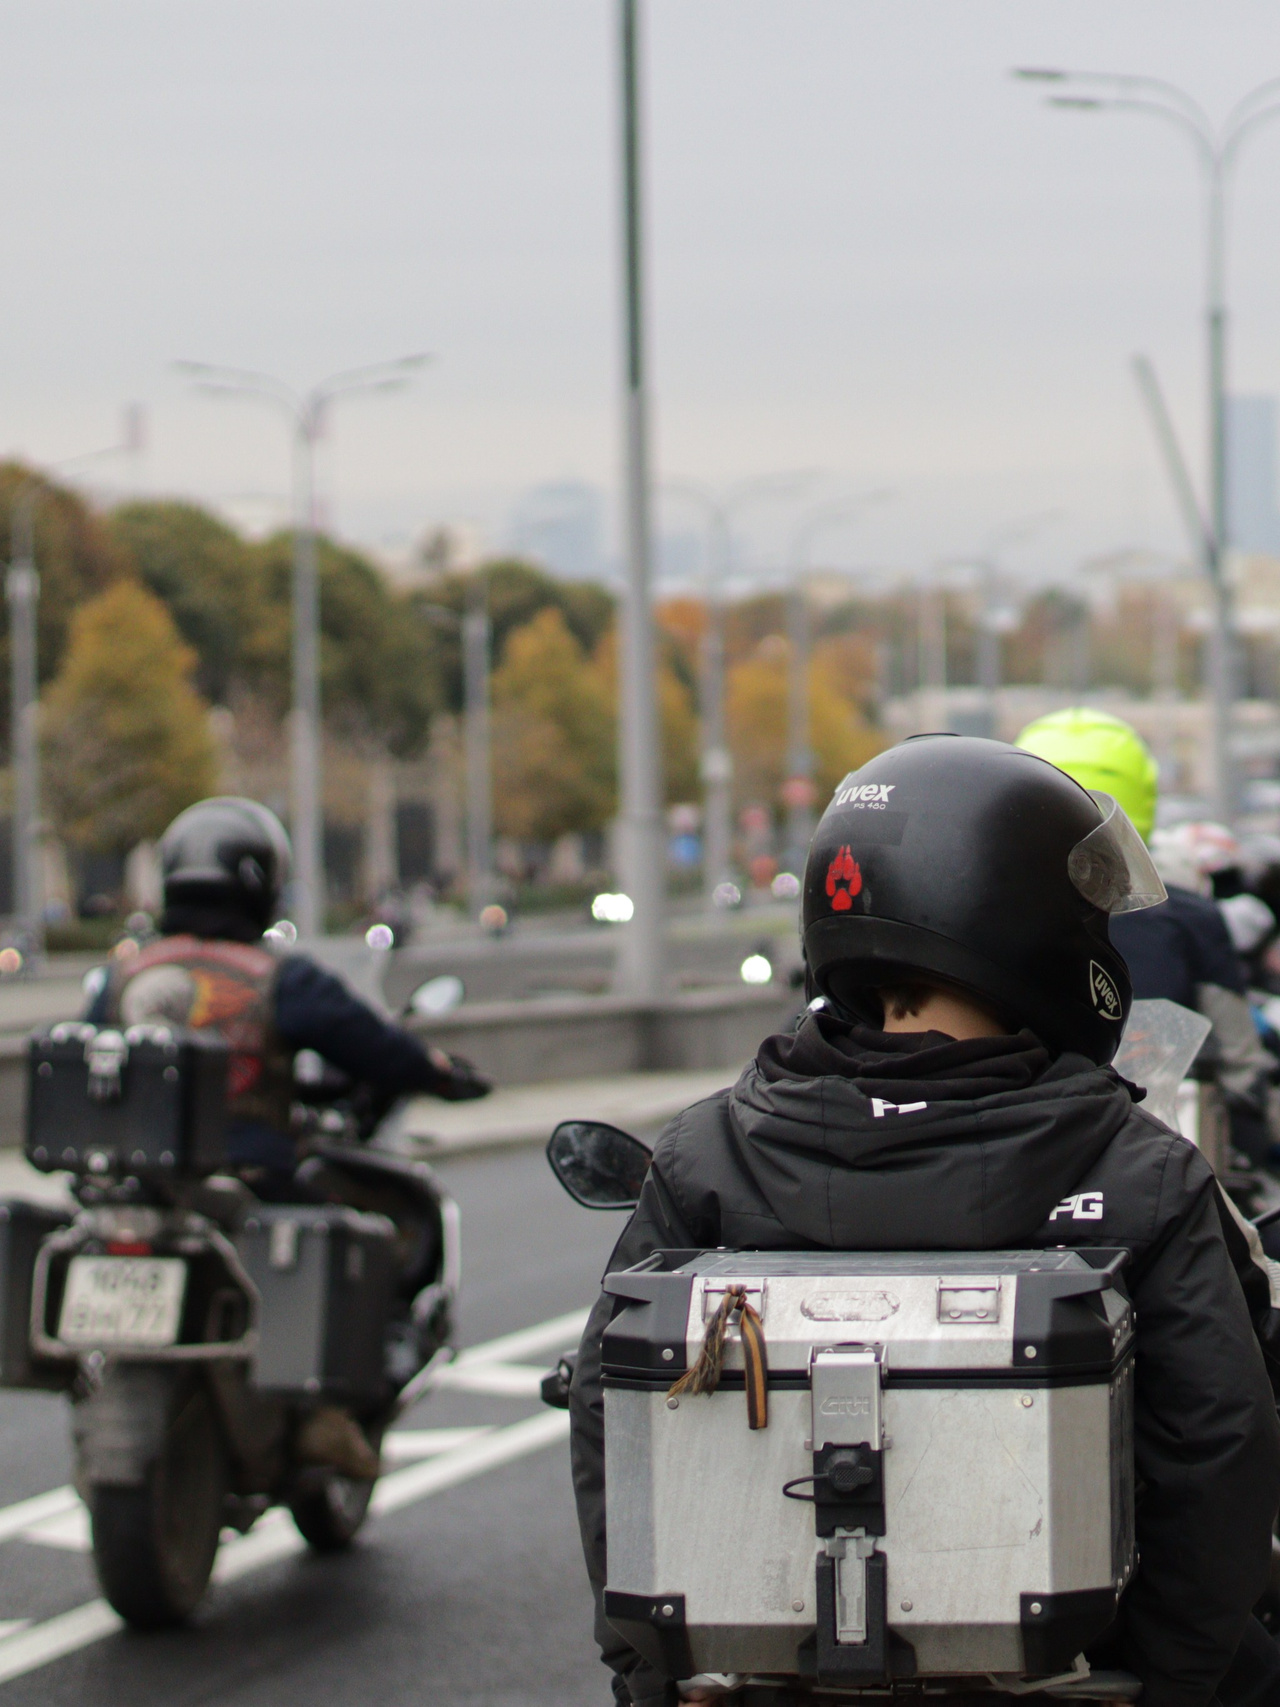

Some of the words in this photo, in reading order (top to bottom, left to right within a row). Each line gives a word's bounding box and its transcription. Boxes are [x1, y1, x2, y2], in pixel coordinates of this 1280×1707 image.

[836, 784, 896, 806] uvex
[867, 802, 886, 810] 480
[1095, 973, 1118, 1014] uvex
